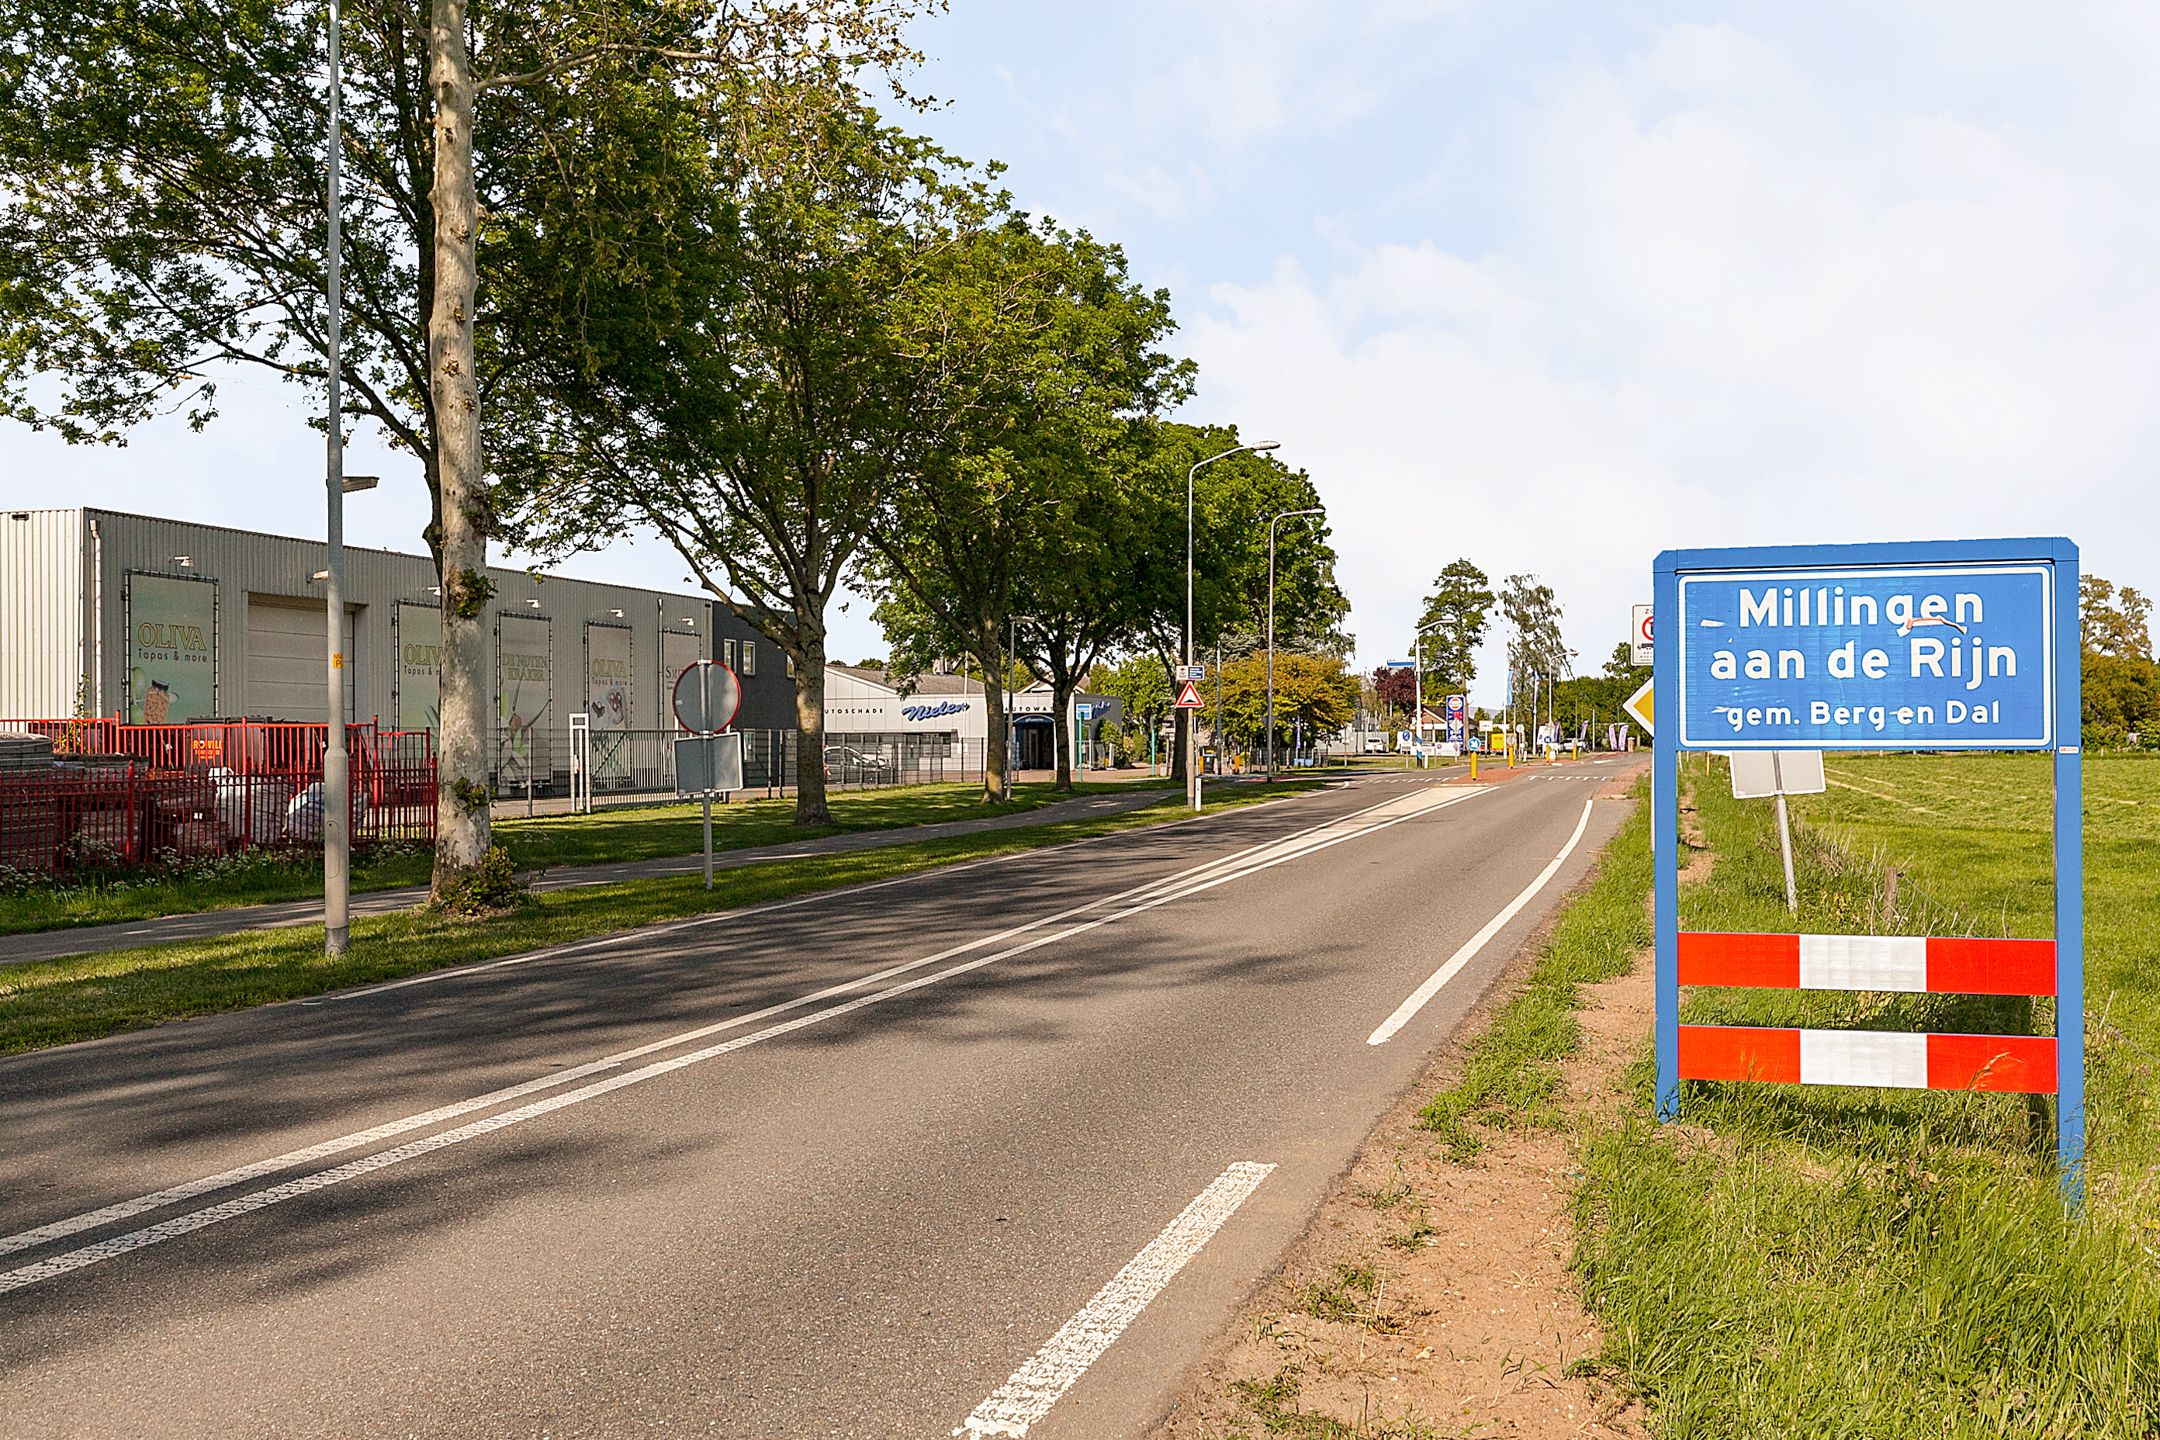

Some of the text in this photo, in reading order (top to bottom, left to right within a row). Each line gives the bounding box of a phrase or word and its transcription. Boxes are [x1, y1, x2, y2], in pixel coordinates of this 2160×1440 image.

[1738, 586, 1984, 637] Millingen
[138, 622, 207, 651] OLIVA
[138, 648, 207, 662] Tapas & more
[404, 643, 442, 667] OLIV
[592, 658, 628, 678] OLIVA
[1710, 636, 2017, 690] aan de Rijn
[404, 665, 425, 677] Tapas
[1727, 700, 2000, 732] gem. Berg en Dal
